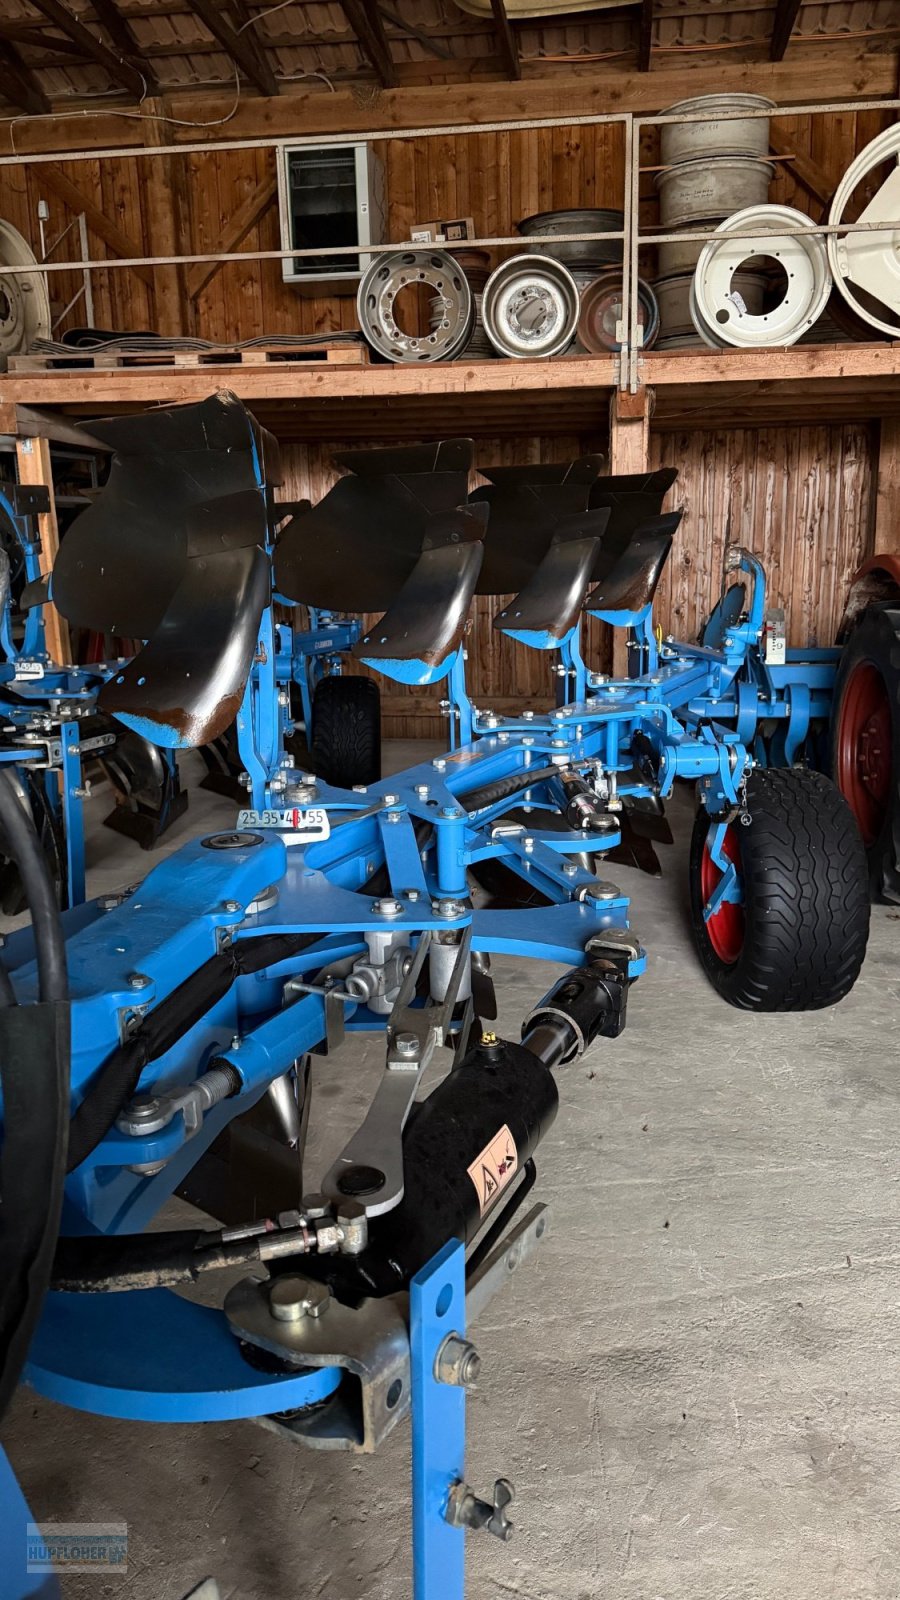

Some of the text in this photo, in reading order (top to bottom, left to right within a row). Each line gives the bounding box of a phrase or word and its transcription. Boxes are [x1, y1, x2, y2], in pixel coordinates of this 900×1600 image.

[242, 812, 257, 825] 25
[263, 812, 278, 825] 35
[308, 811, 323, 824] 55
